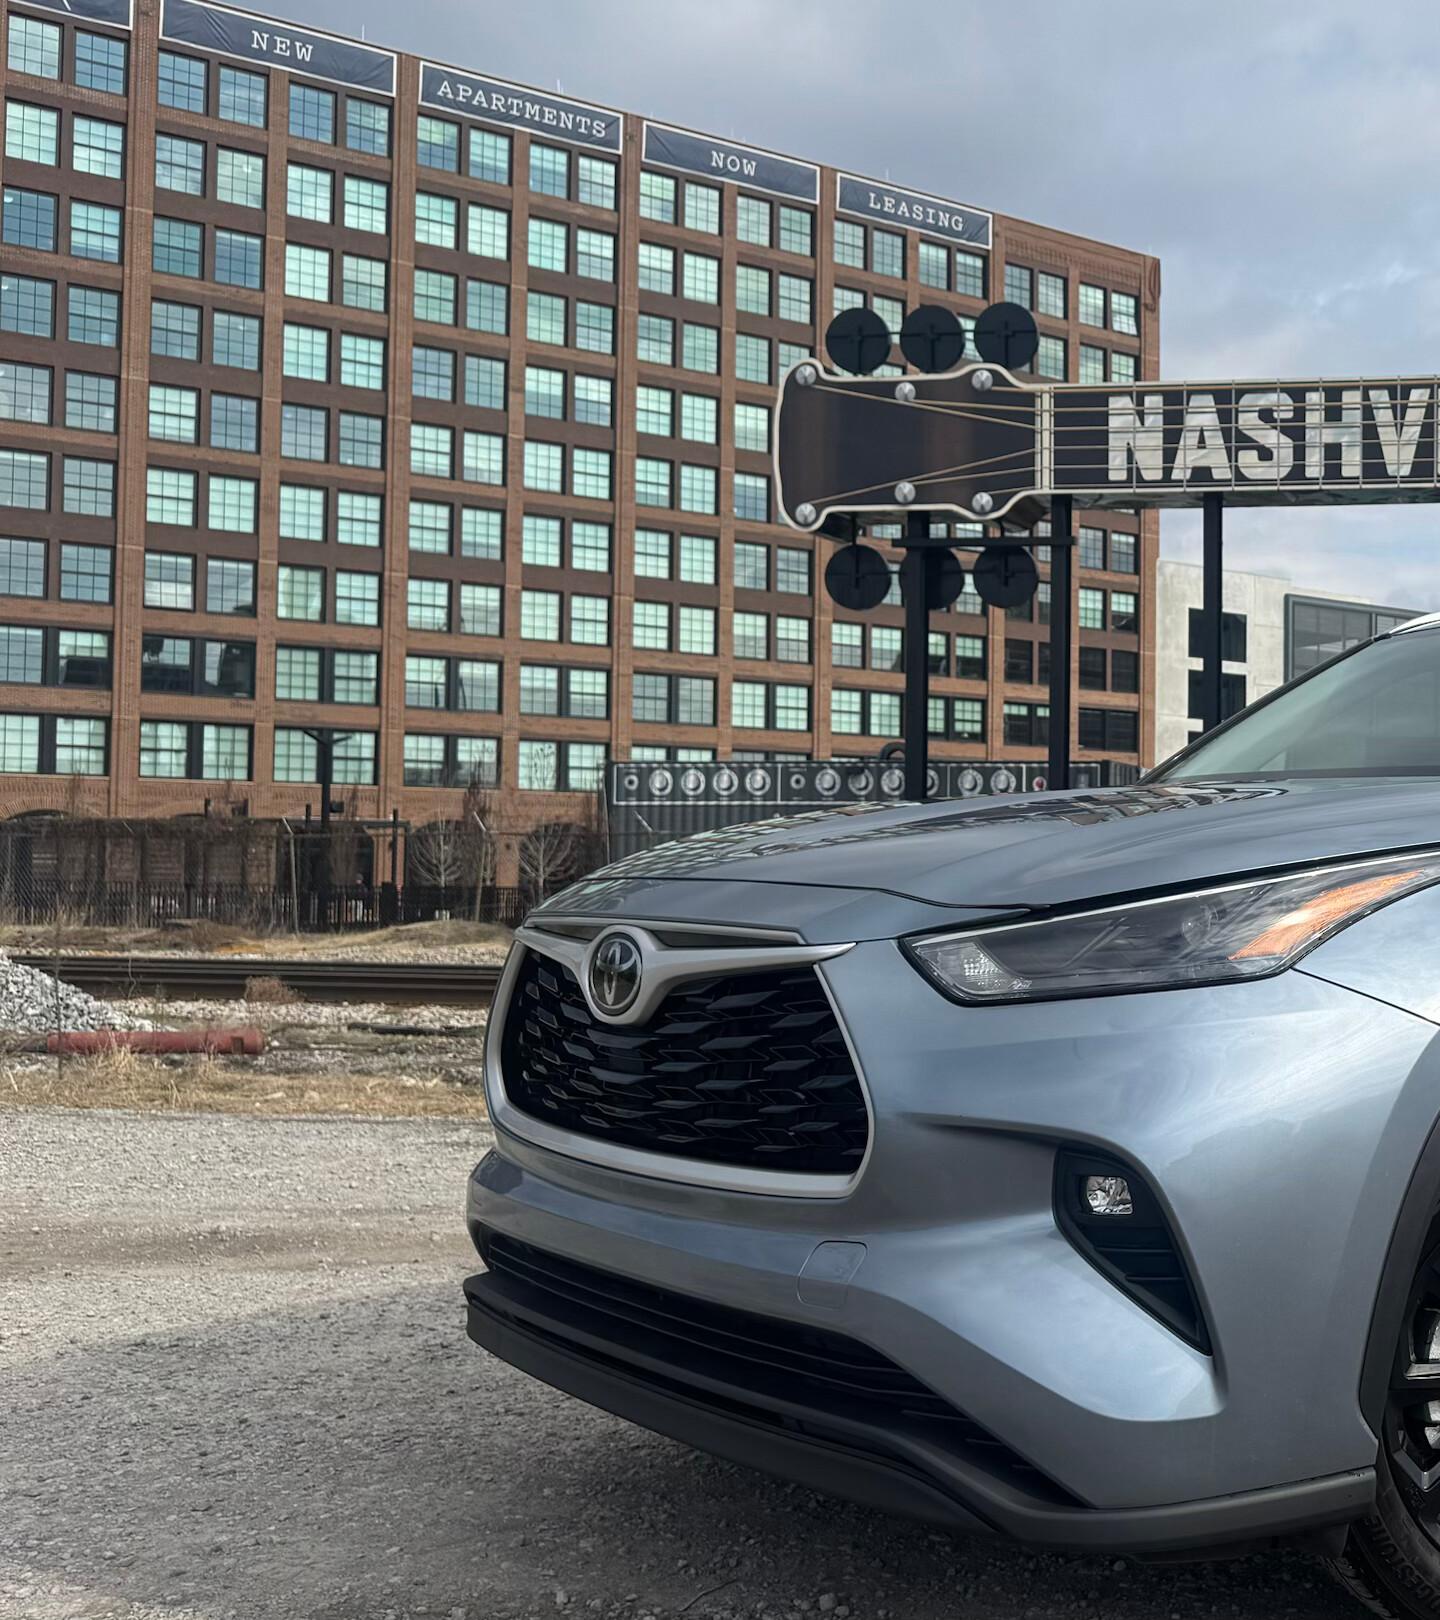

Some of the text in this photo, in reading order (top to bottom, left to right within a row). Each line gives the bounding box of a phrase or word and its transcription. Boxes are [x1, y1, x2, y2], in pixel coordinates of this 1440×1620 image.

[251, 30, 313, 62] NEW
[437, 80, 606, 138] APARTMENTS
[711, 150, 756, 177] NOW
[868, 192, 964, 232] LEASING
